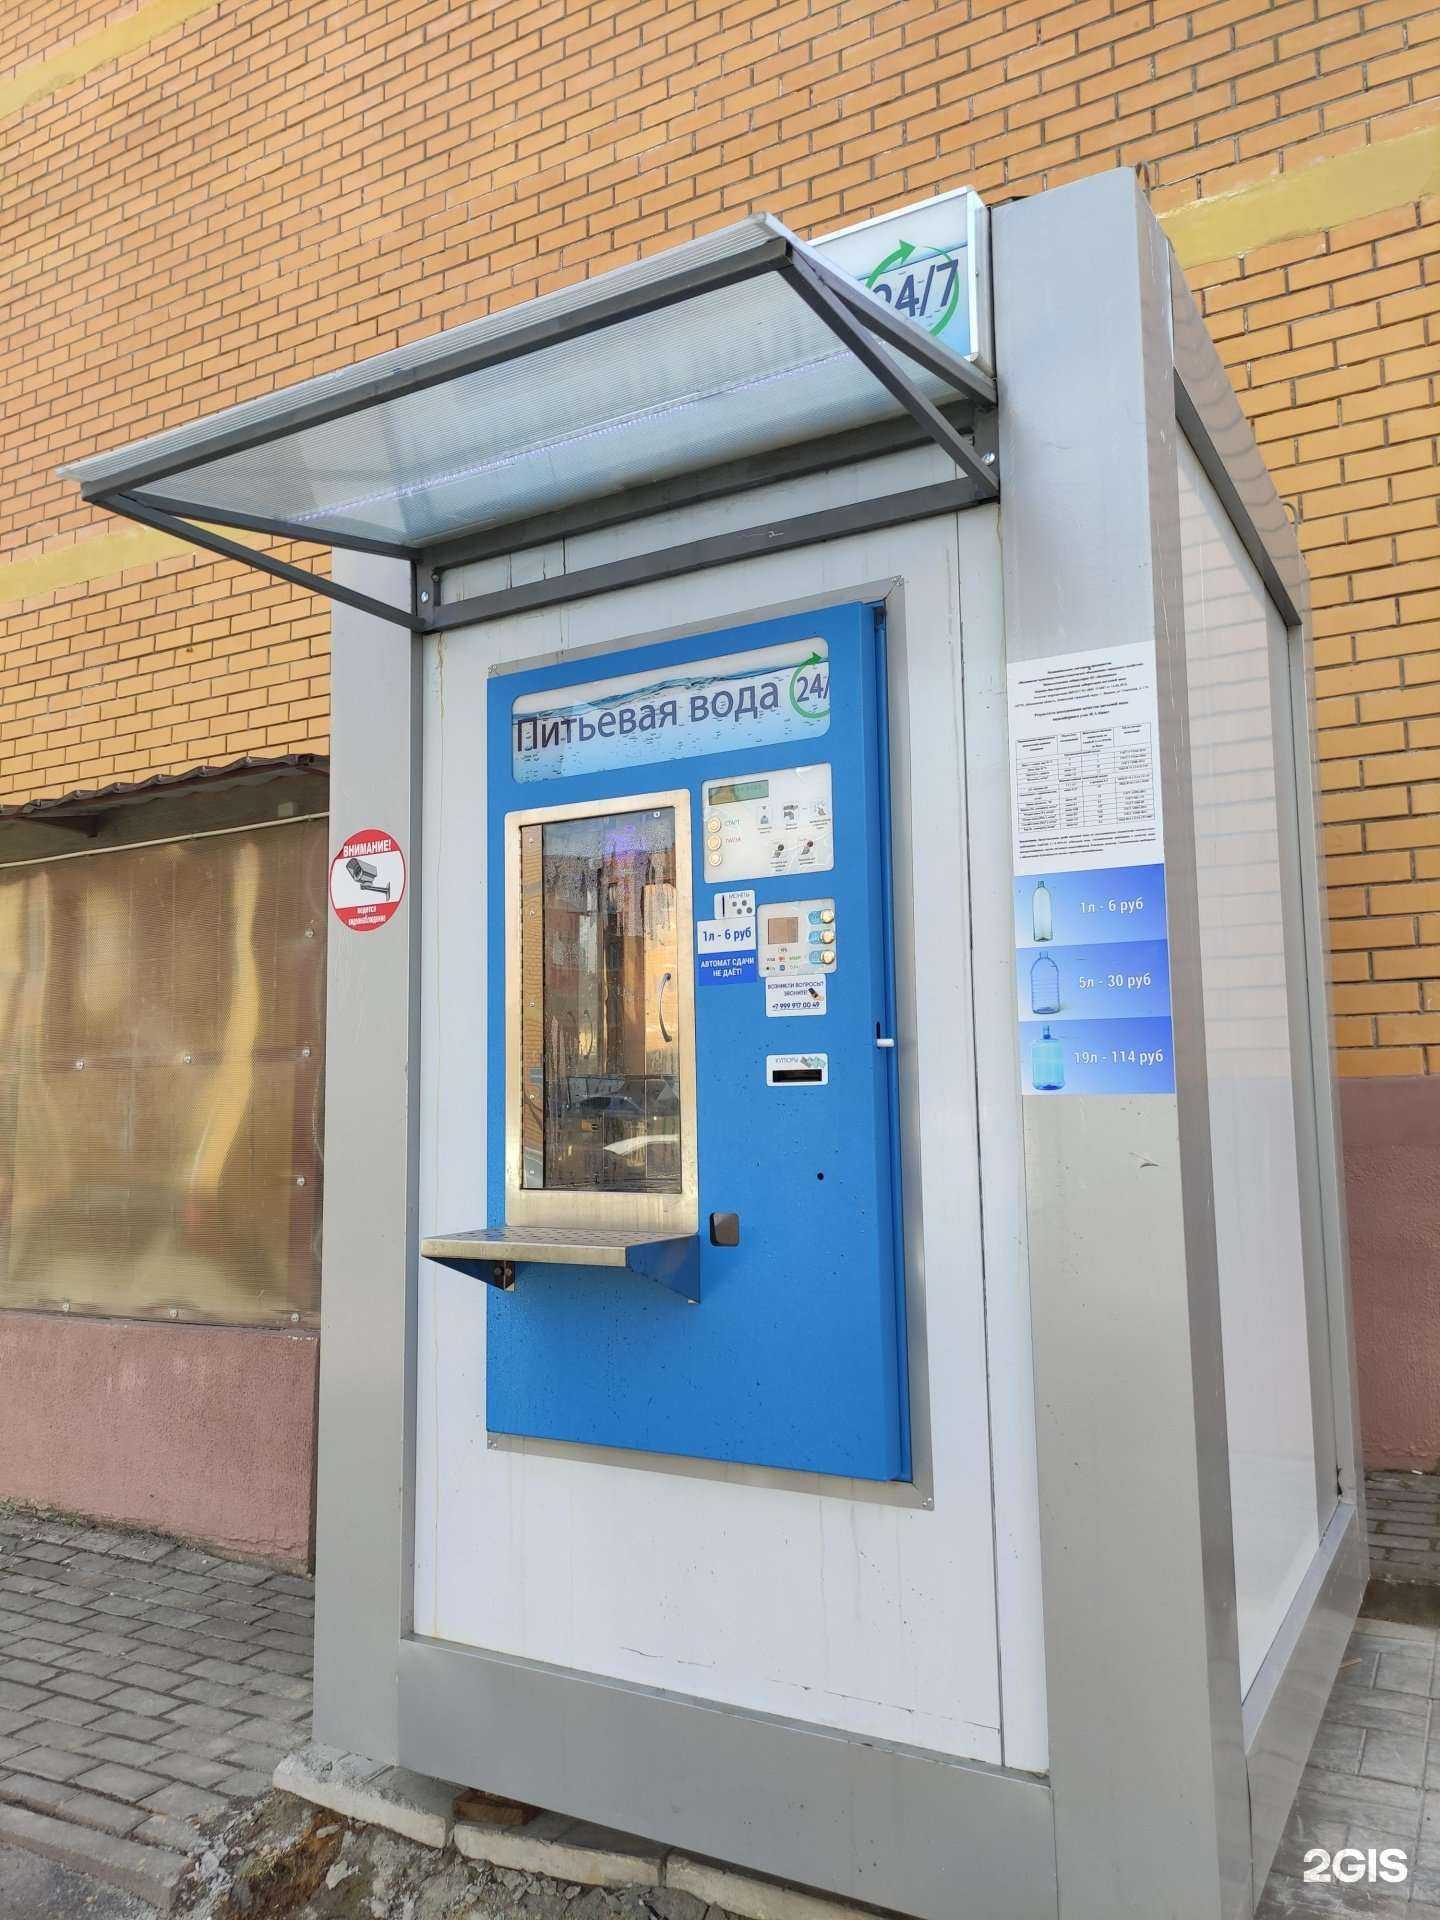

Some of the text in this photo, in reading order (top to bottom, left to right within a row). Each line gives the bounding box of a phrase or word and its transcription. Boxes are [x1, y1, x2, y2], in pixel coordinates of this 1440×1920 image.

[517, 681, 780, 752] Питьевая вода
[343, 840, 392, 857] ВНИМАНИЕ!
[1108, 899, 1117, 912] 6
[1120, 896, 1144, 914] руб
[724, 928, 731, 940] 6
[734, 926, 752, 942] руб
[701, 956, 754, 968] АВТОМАТ СДАЧИ
[712, 969, 722, 977] НЕ
[1079, 976, 1094, 989] 5л
[1107, 974, 1124, 987] 30
[1127, 972, 1151, 989] руб
[1112, 1050, 1136, 1063] 114
[1139, 1048, 1164, 1066] руб
